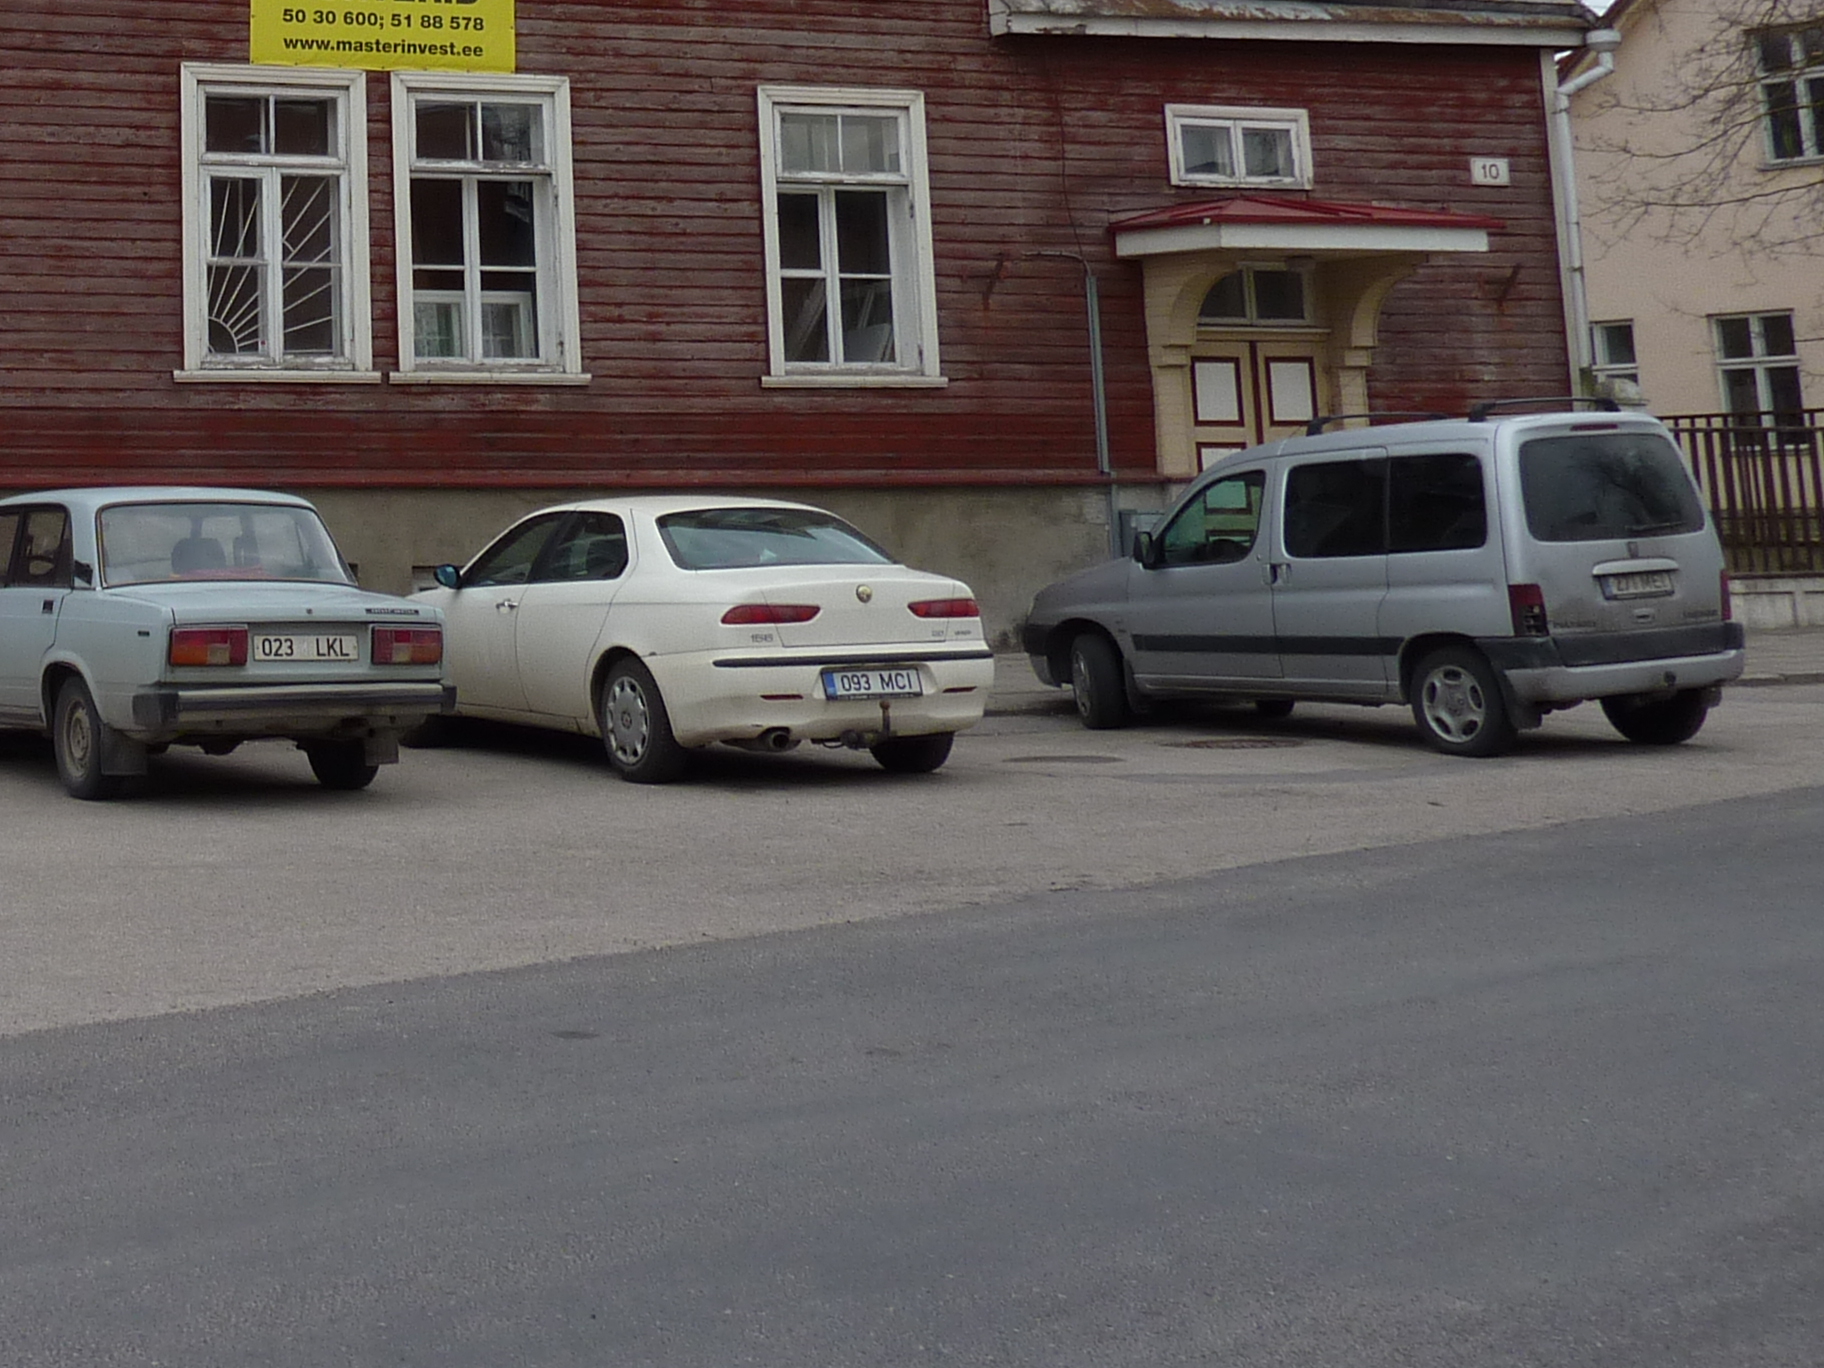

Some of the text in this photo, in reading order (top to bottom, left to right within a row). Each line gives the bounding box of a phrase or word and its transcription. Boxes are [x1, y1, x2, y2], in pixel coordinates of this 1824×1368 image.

[282, 9, 484, 31] 50 30 600; 51 88 578
[283, 37, 483, 56] www.masterinvest.ee
[1481, 163, 1500, 180] 10
[261, 638, 350, 657] 023 LKL
[840, 672, 913, 692] 093 MCI
